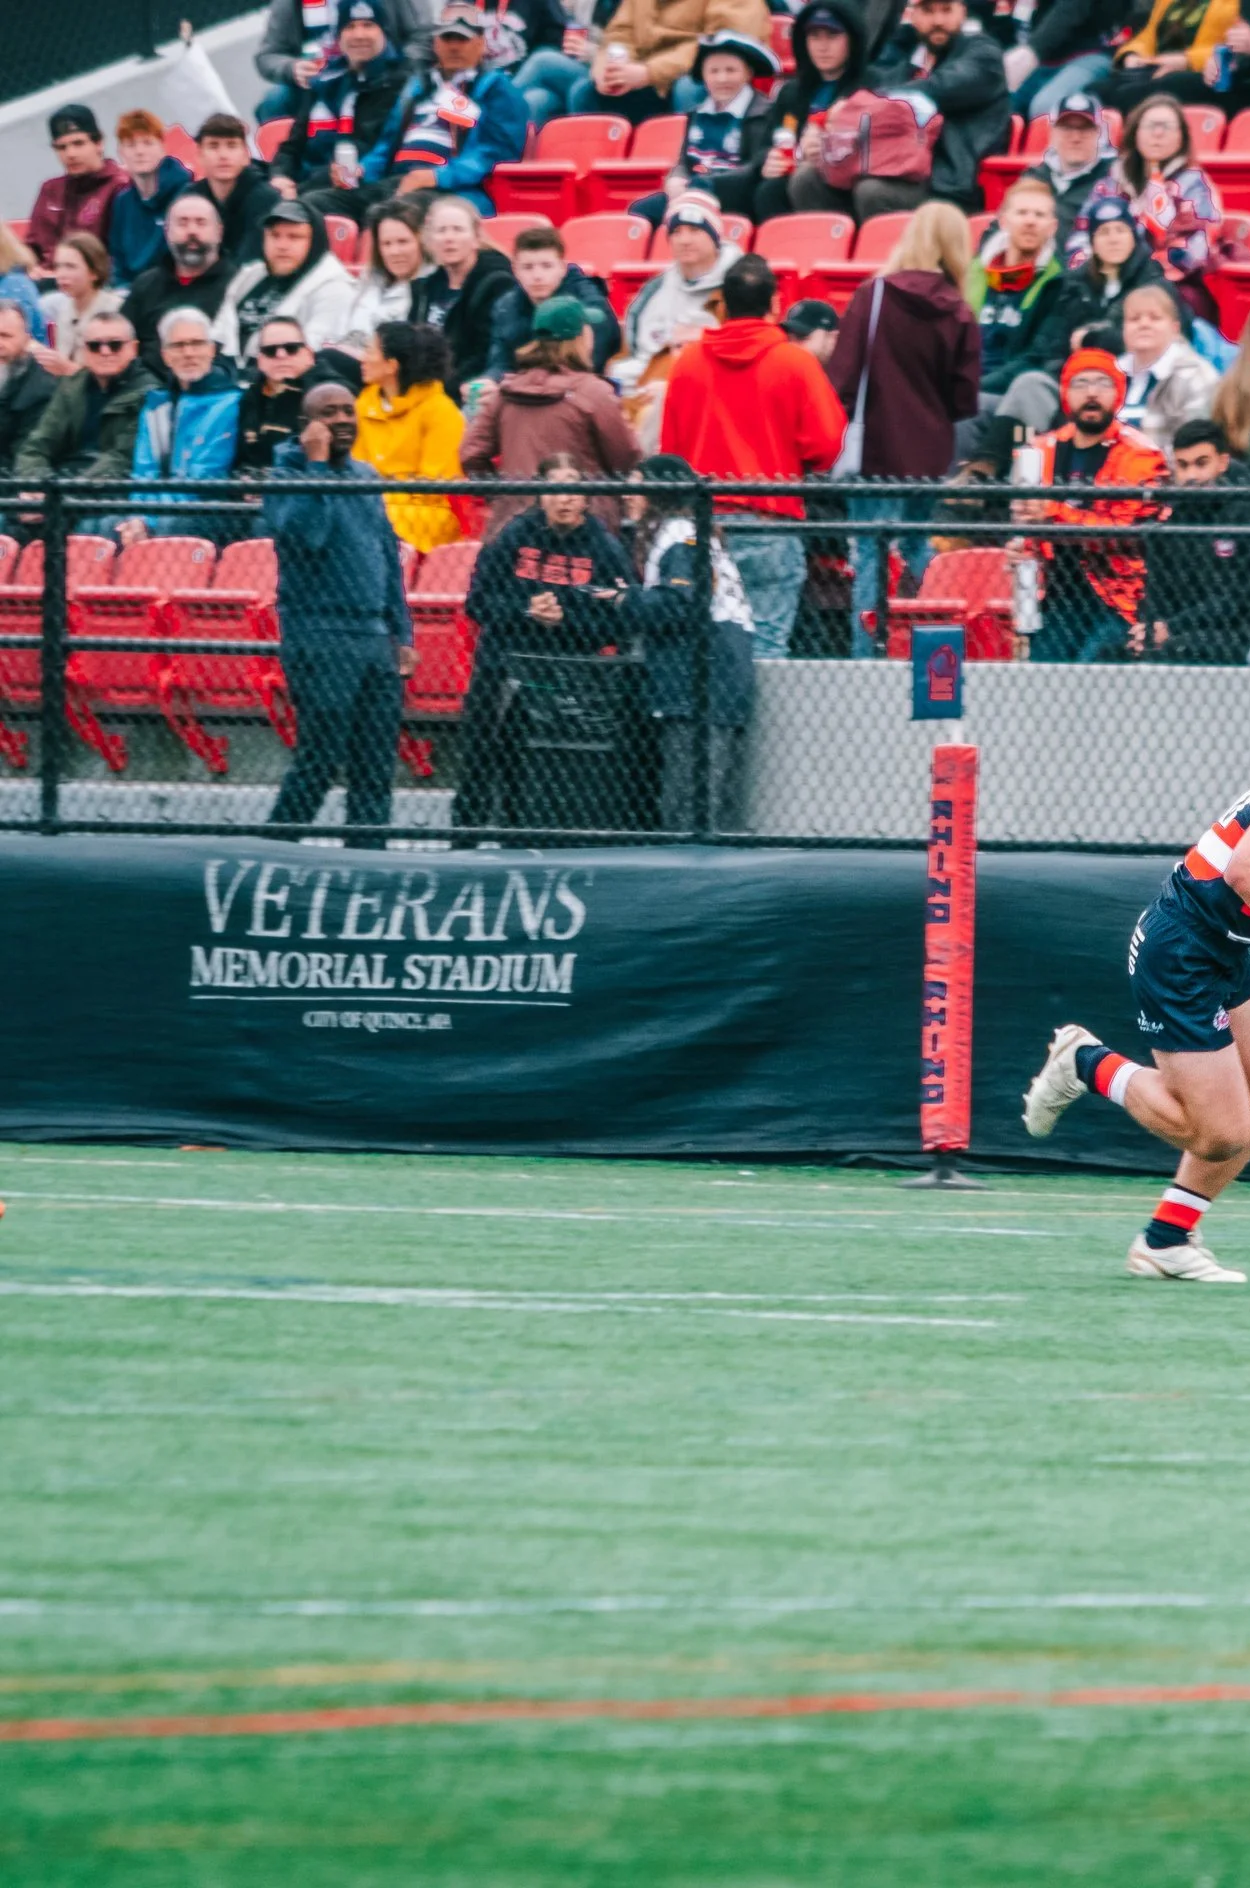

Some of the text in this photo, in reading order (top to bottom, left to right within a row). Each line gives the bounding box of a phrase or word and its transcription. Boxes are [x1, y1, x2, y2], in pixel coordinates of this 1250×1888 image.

[202, 859, 594, 941] VETERANS
[190, 945, 577, 993] MEMORIAL STADIUM
